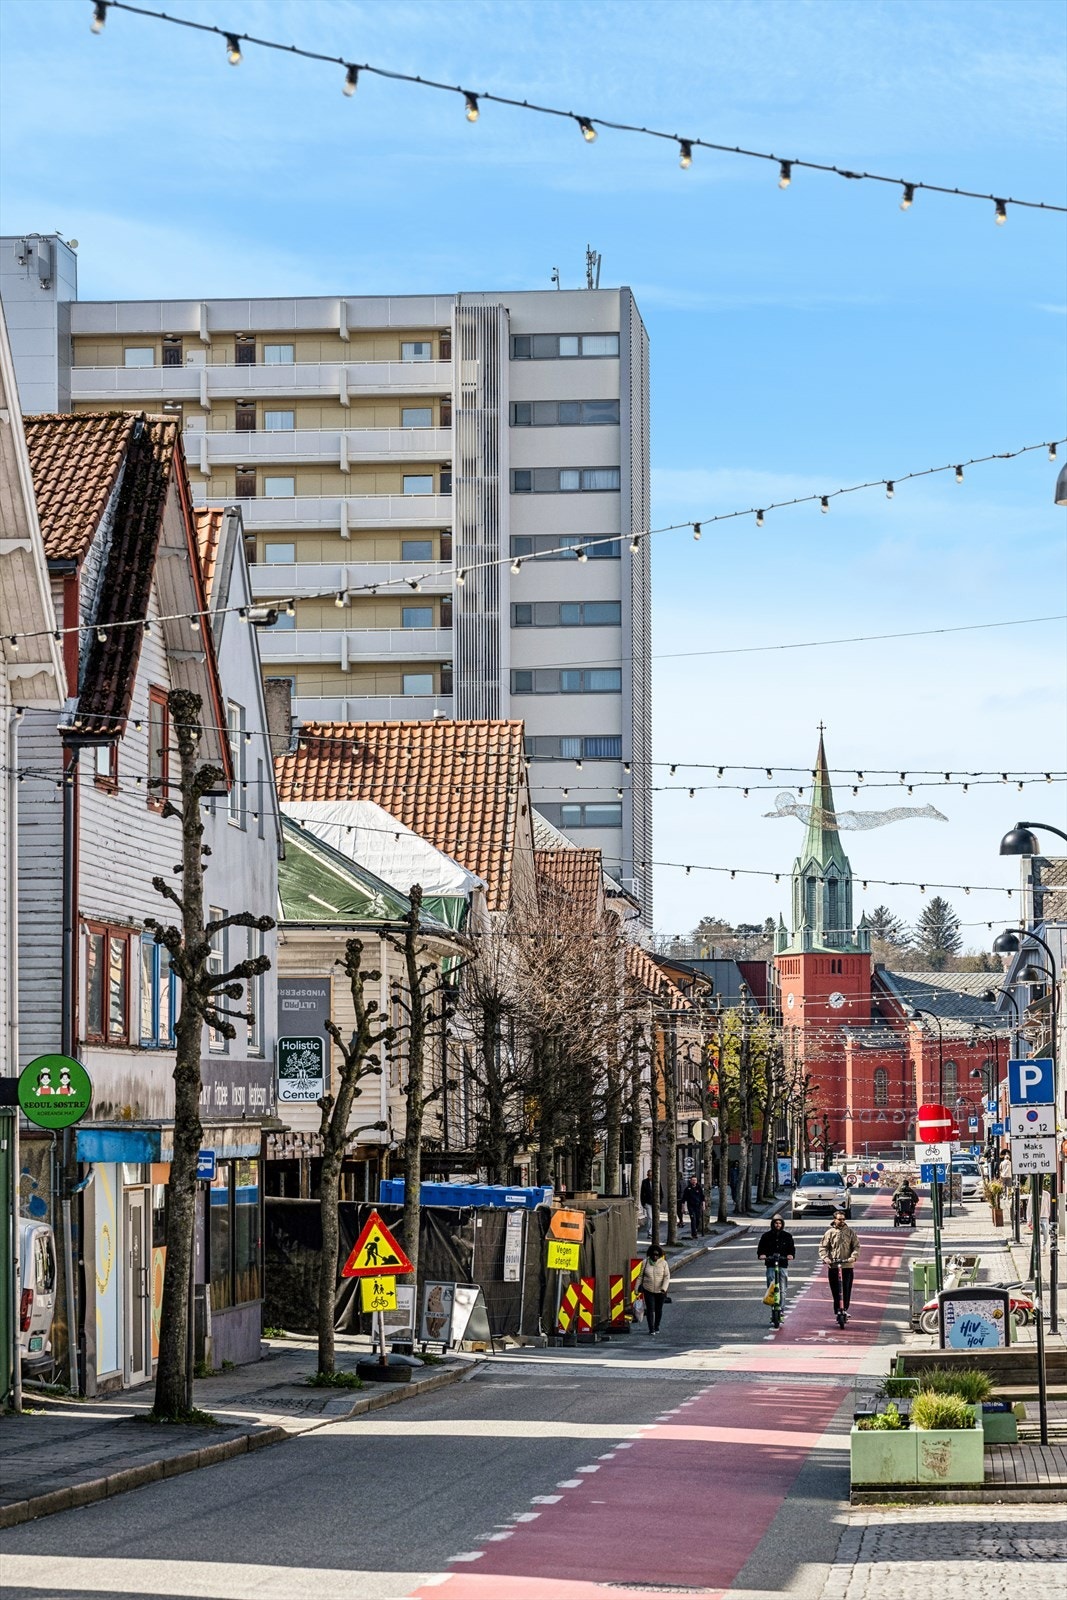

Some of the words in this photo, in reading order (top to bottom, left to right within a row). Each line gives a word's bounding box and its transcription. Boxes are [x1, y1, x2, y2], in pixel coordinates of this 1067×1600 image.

[279, 989, 326, 997] VINDSPERR
[282, 1040, 320, 1050] Holistic
[1019, 1065, 1043, 1099] P
[282, 1090, 320, 1099] Center
[24, 1101, 52, 1109] SEOUL
[53, 1101, 86, 1109] SØSTRE
[1018, 1124, 1024, 1132] 9
[1039, 1124, 1047, 1132] 12
[1018, 1161, 1037, 1169] øvrig
[556, 1245, 572, 1255] Vegen
[554, 1257, 571, 1267] stengt
